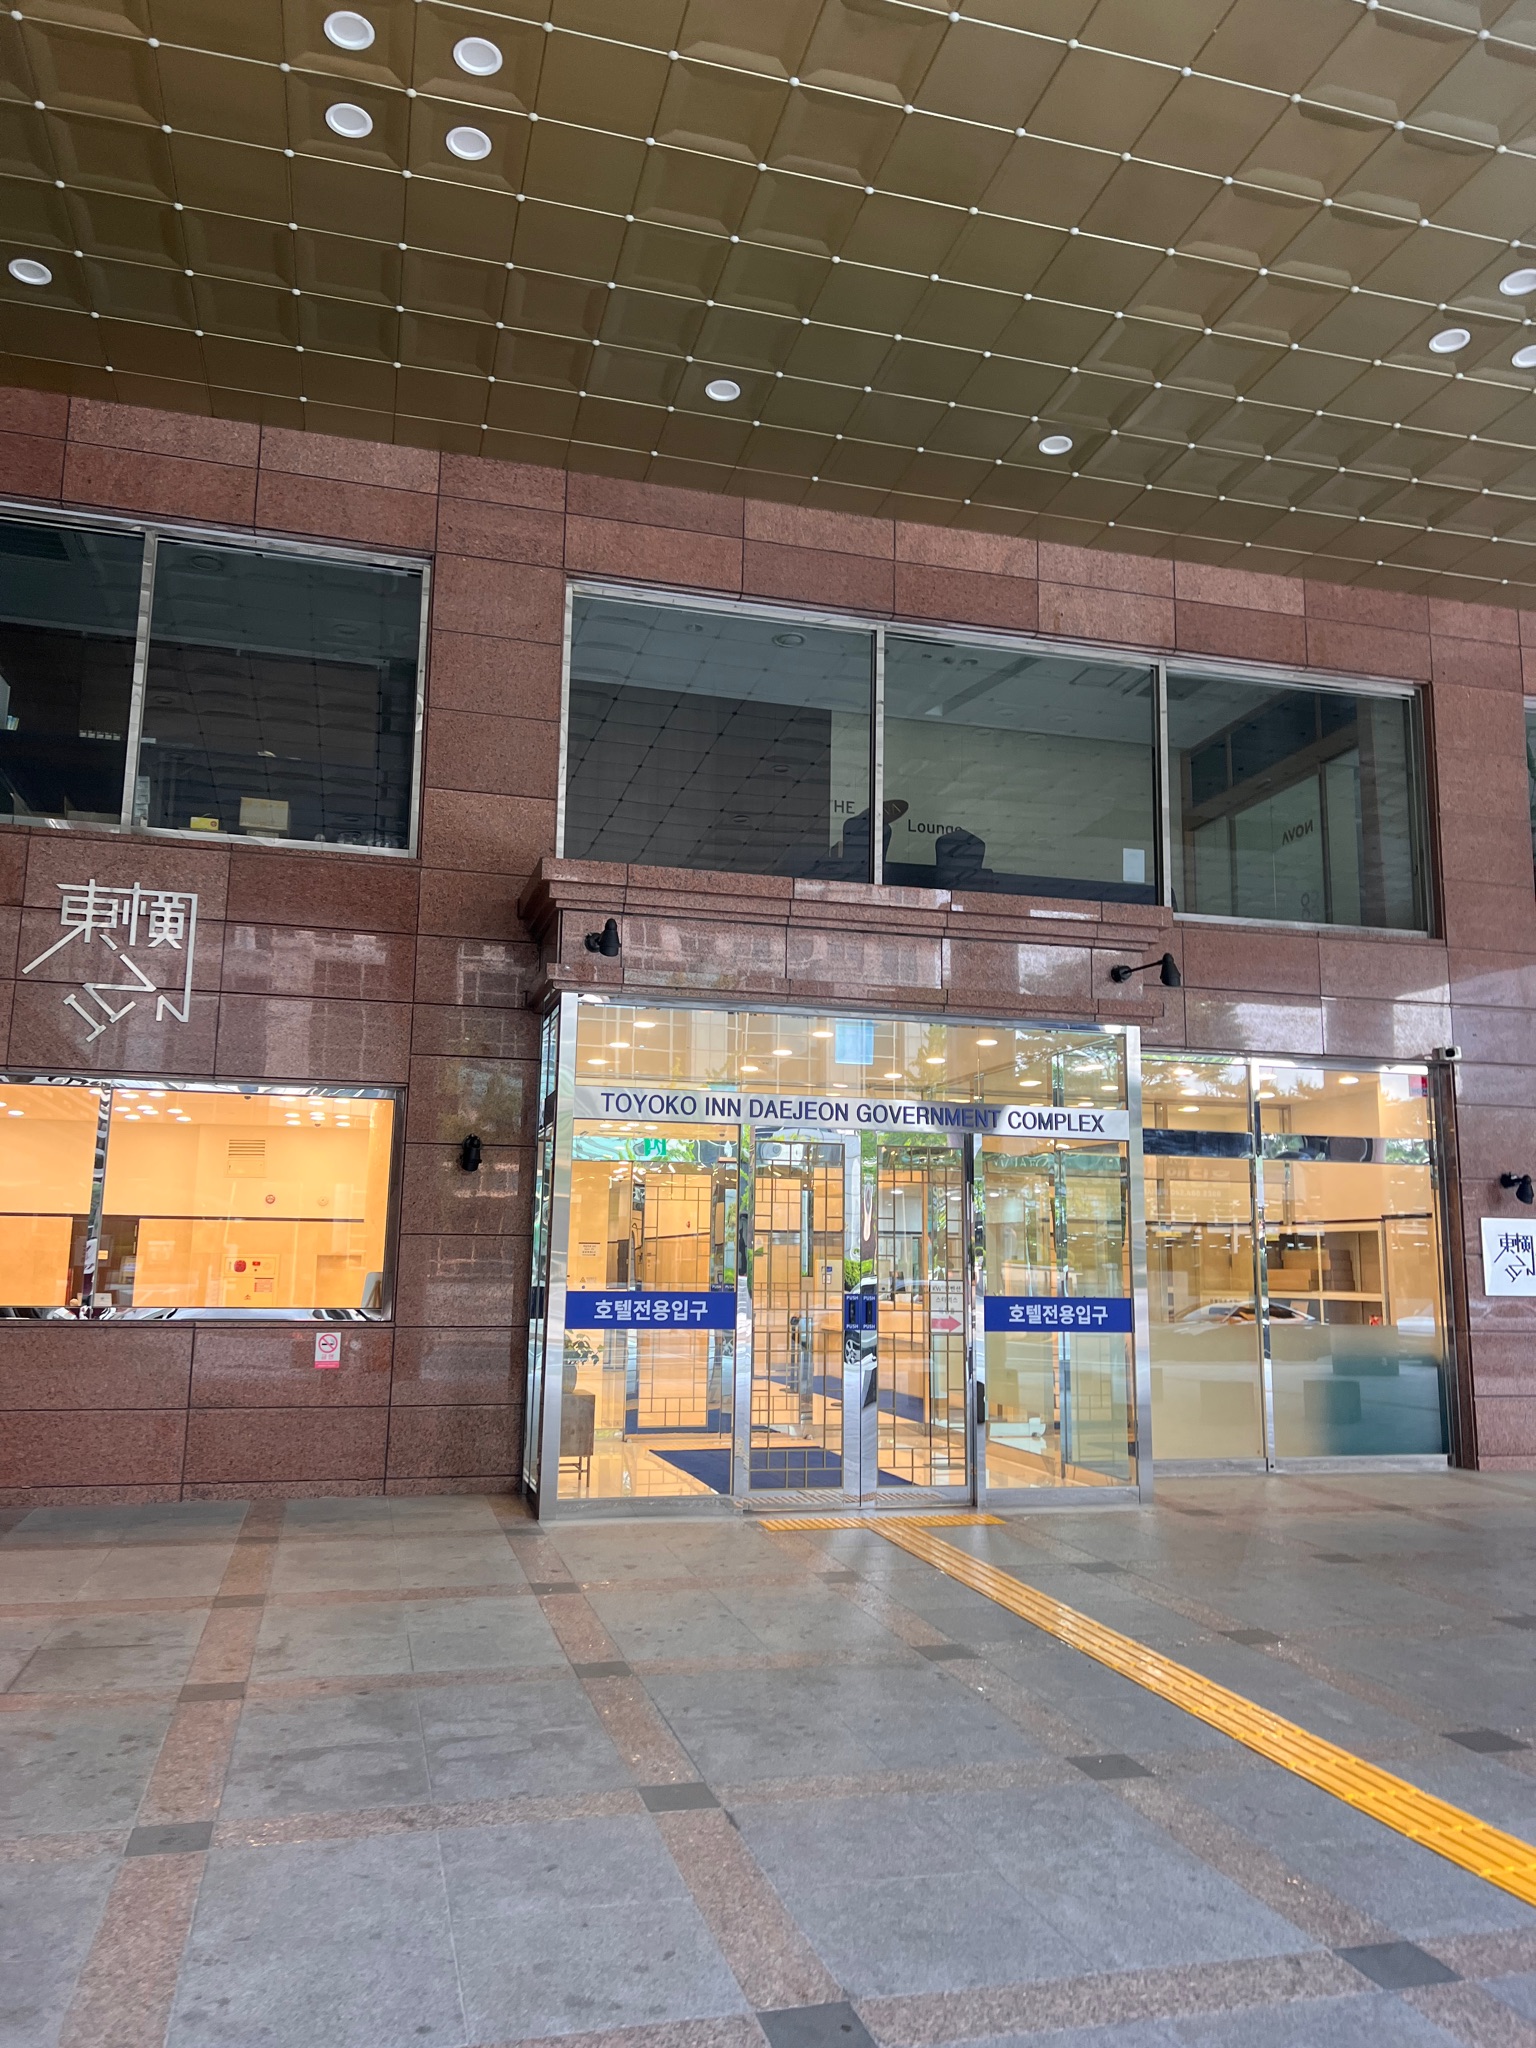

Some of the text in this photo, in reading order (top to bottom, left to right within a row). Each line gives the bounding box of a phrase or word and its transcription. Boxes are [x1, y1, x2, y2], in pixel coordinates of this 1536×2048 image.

[601, 1092, 1105, 1133] TOYOKO INN DAEJEON GOVERNMENT COMPLEX
[593, 1299, 709, 1321] 호텔전용입구
[1008, 1304, 1109, 1325] 호텔전용입구
